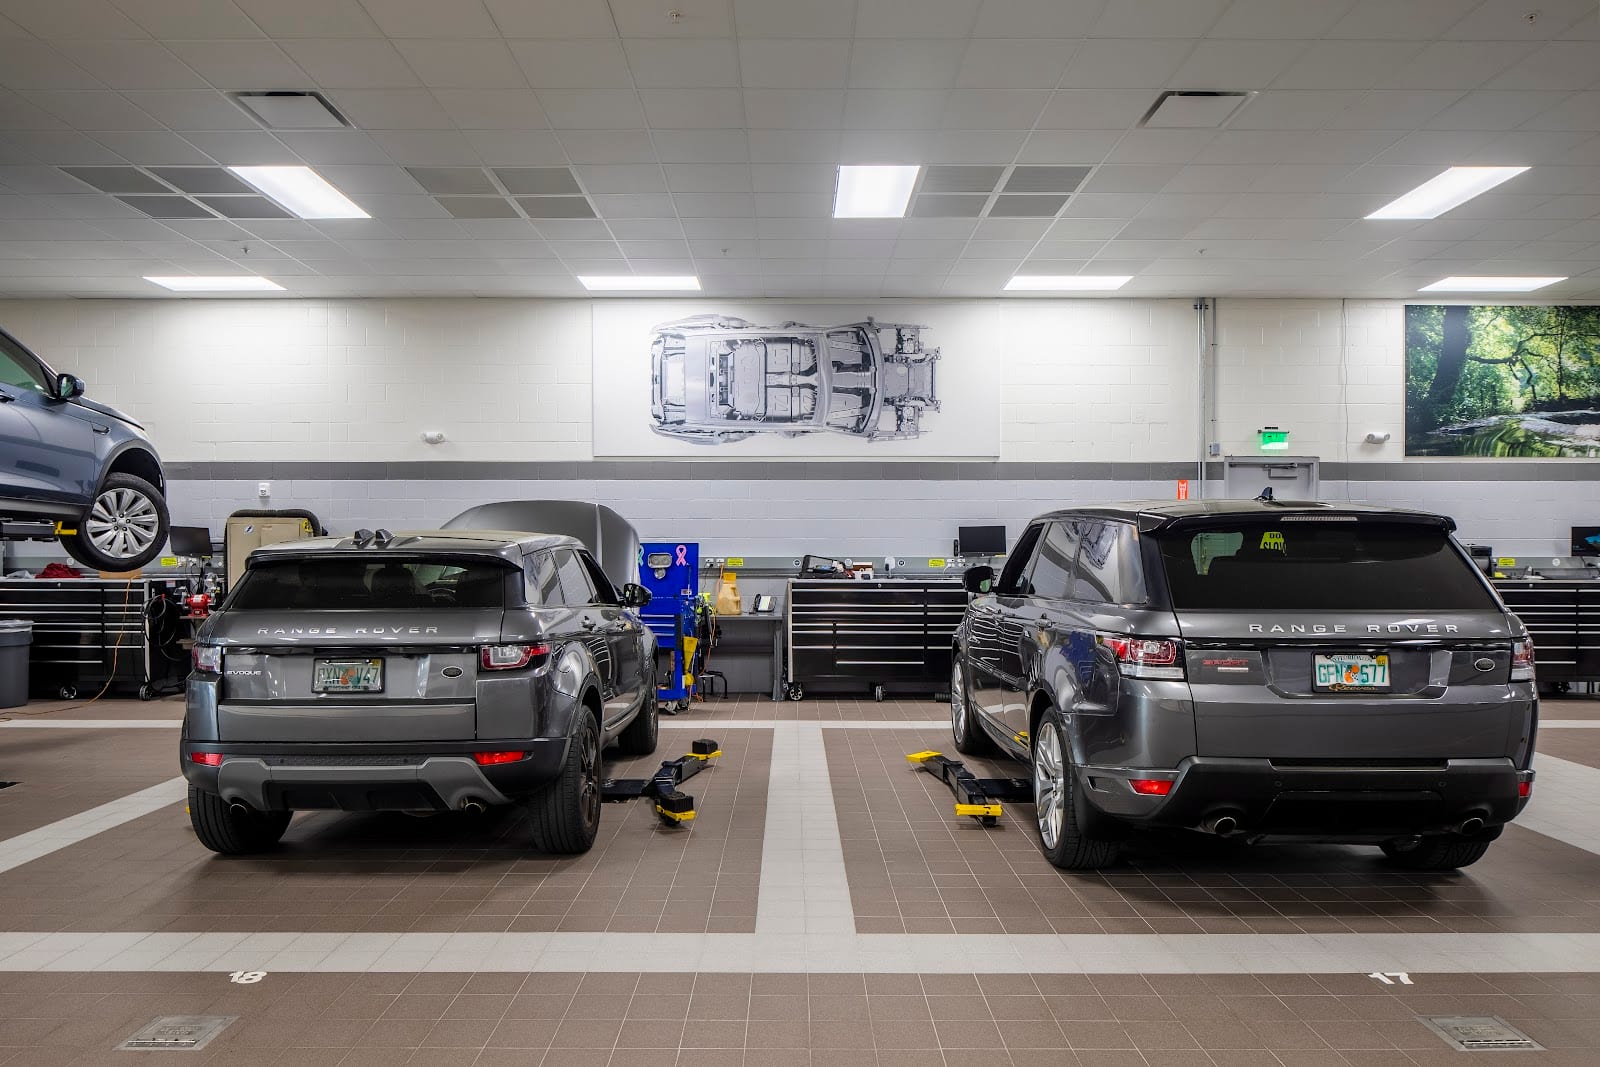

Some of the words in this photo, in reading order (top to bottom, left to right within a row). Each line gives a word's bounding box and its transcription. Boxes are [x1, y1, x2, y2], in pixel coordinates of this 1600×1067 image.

[257, 627, 337, 635] RANGE
[355, 626, 438, 634] ROVER
[1248, 624, 1347, 633] RANGE
[1367, 624, 1459, 633] ROVER
[1368, 972, 1414, 984] 17
